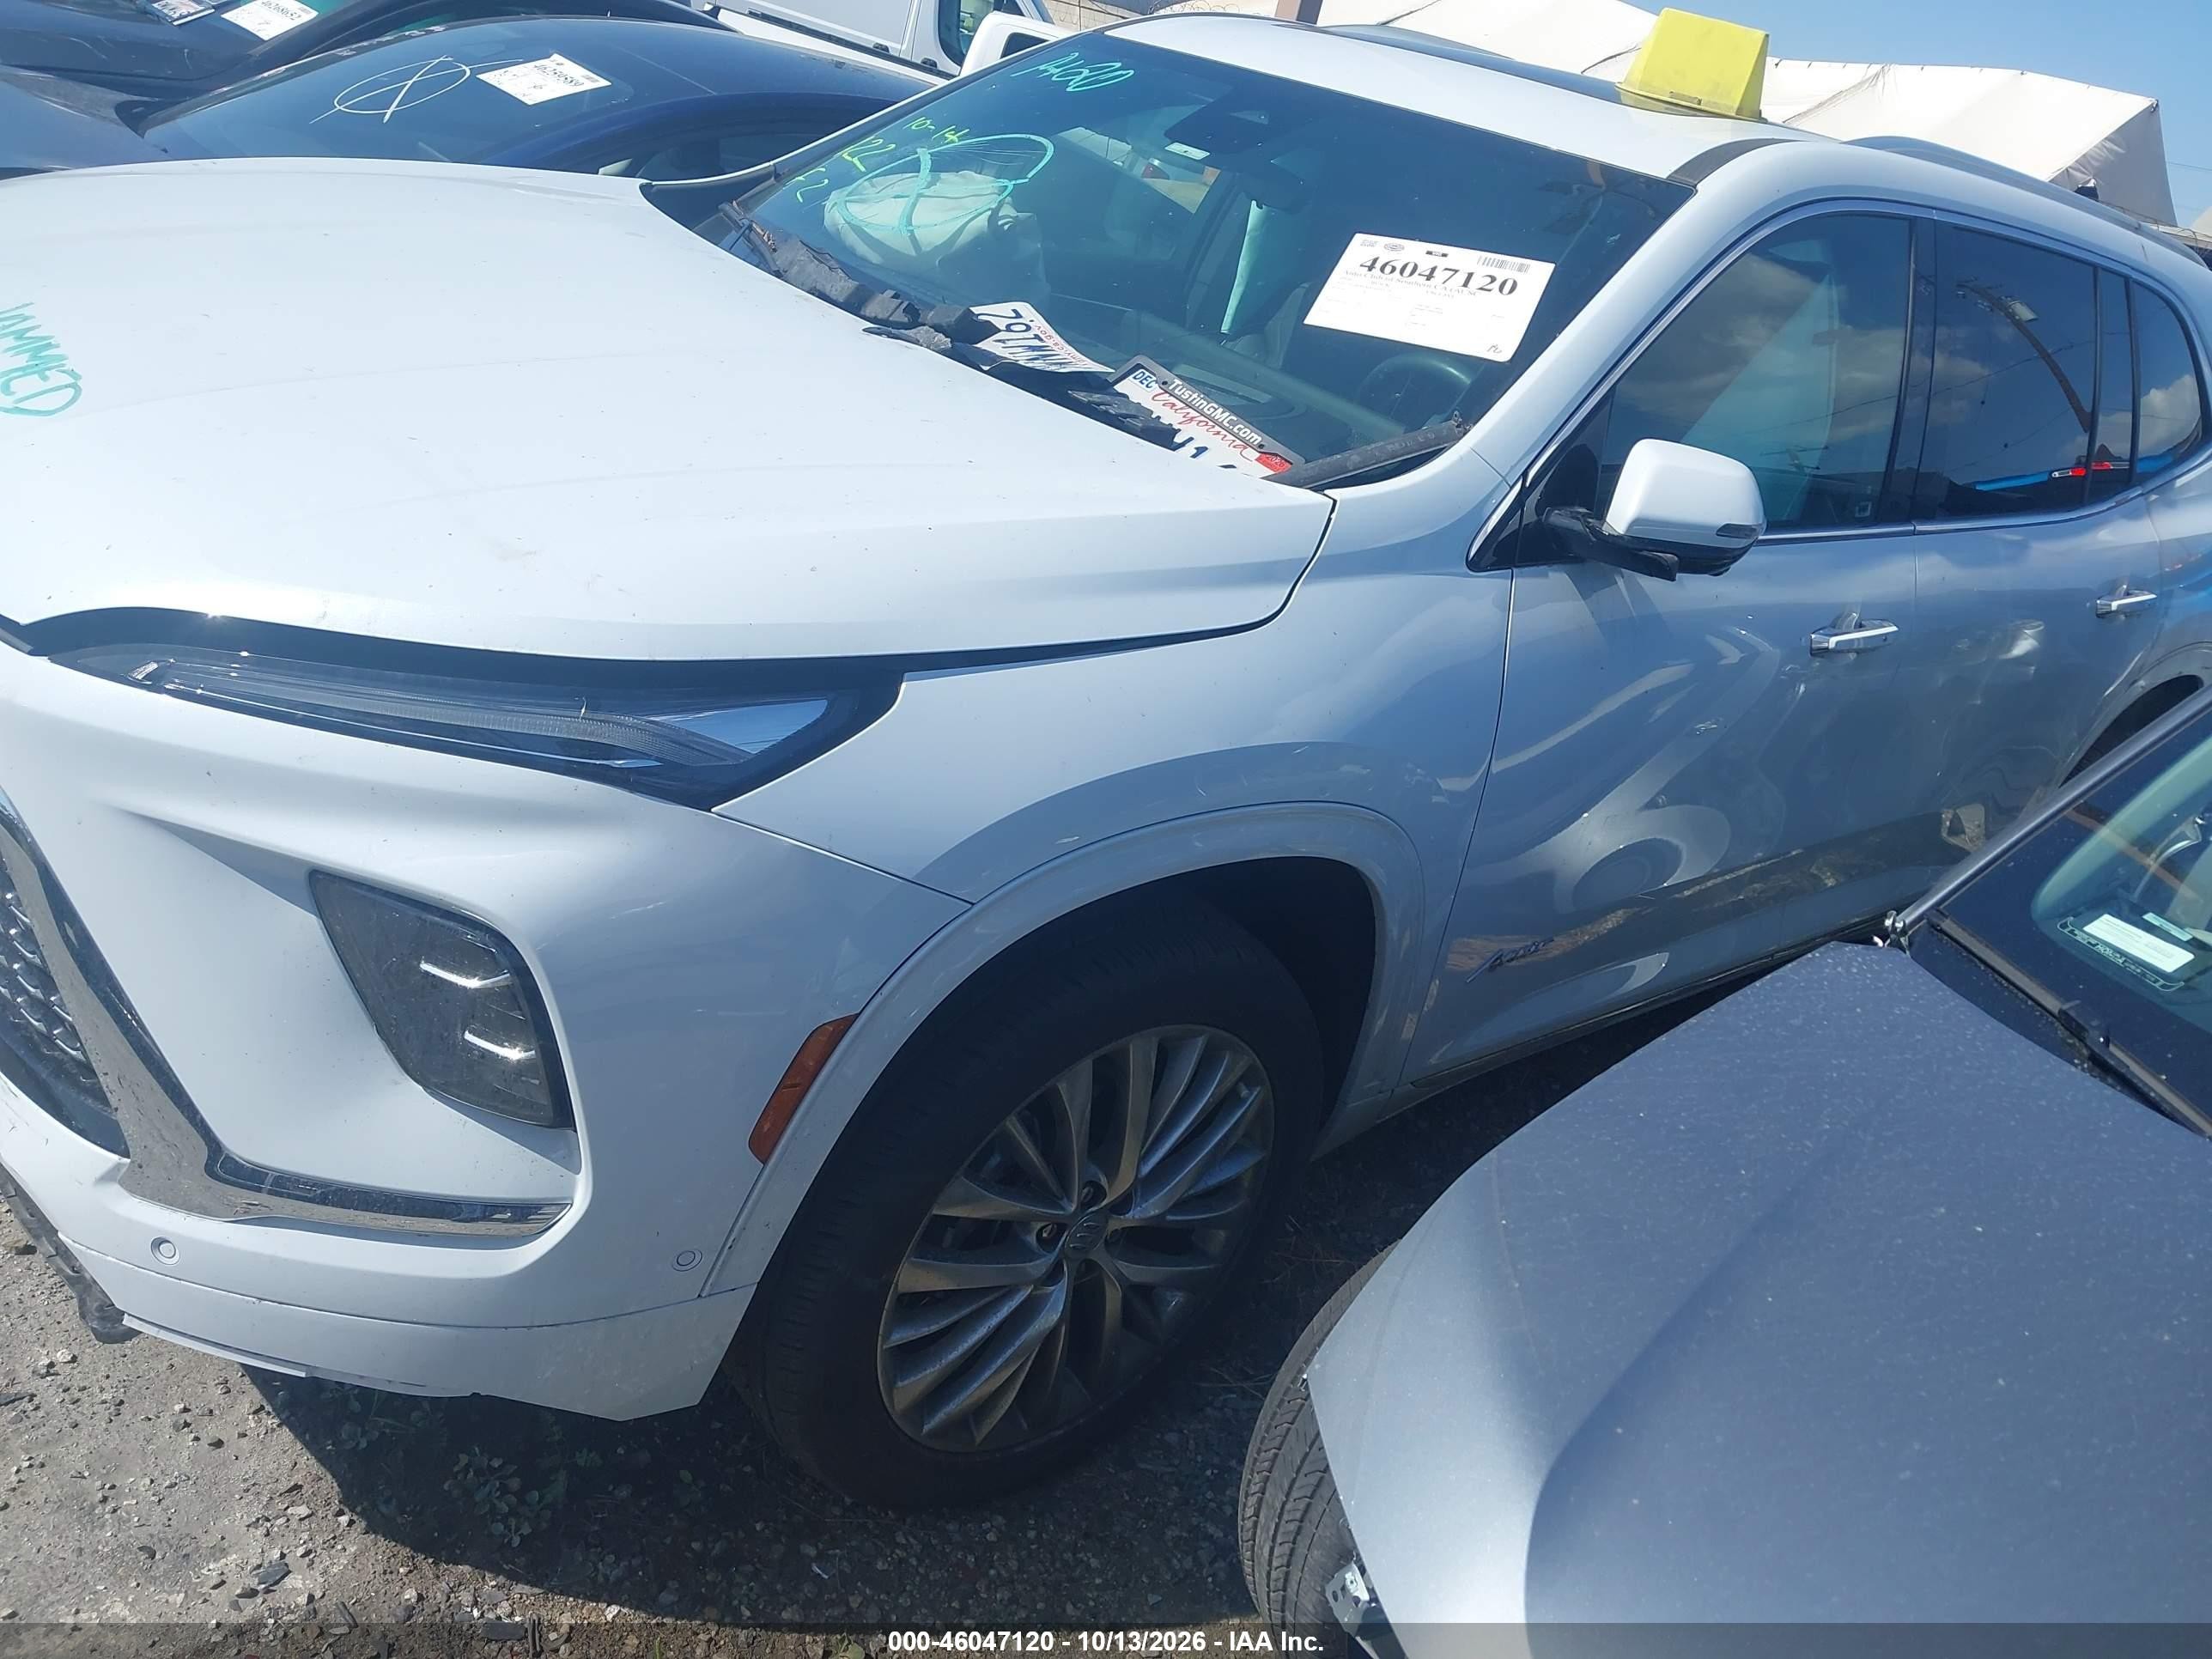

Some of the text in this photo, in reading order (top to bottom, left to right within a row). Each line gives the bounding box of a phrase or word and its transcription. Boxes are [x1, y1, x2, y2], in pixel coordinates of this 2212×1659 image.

[1359, 256, 1518, 296] 46047120
[1133, 370, 1158, 389] DEC
[1169, 379, 1262, 446] TustinGMC.com
